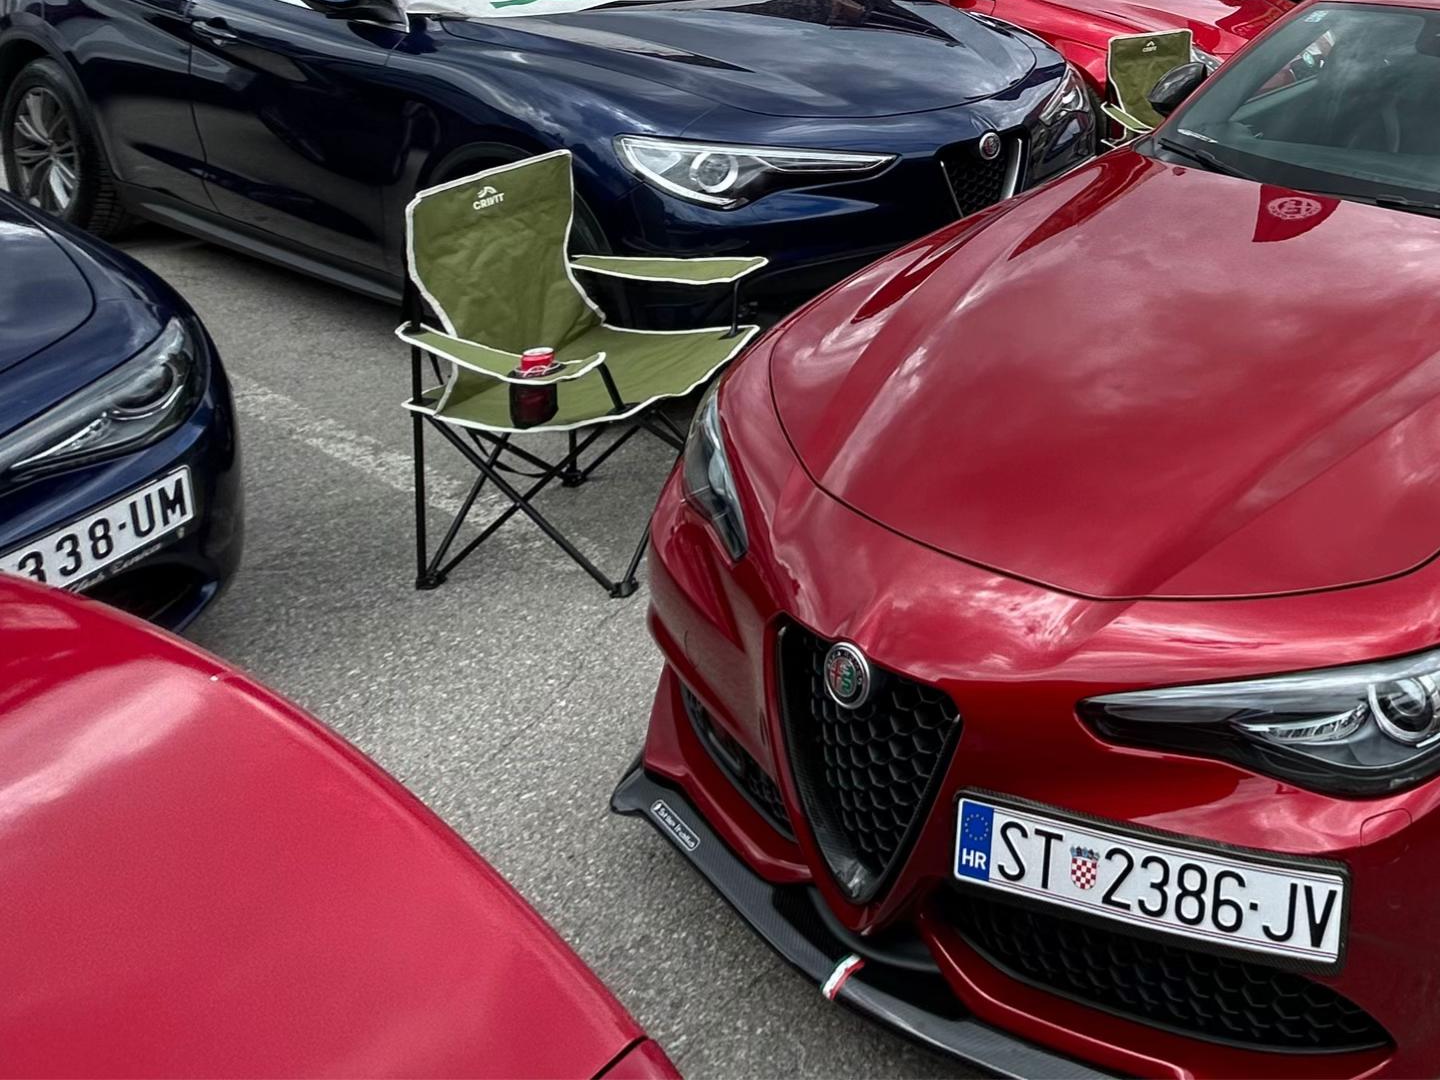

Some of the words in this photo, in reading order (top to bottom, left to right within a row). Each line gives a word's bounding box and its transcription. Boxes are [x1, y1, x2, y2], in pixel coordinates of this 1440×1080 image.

[961, 847, 987, 870] HR
[997, 821, 1064, 890] ST
[1101, 847, 1338, 949] 2386-JV
